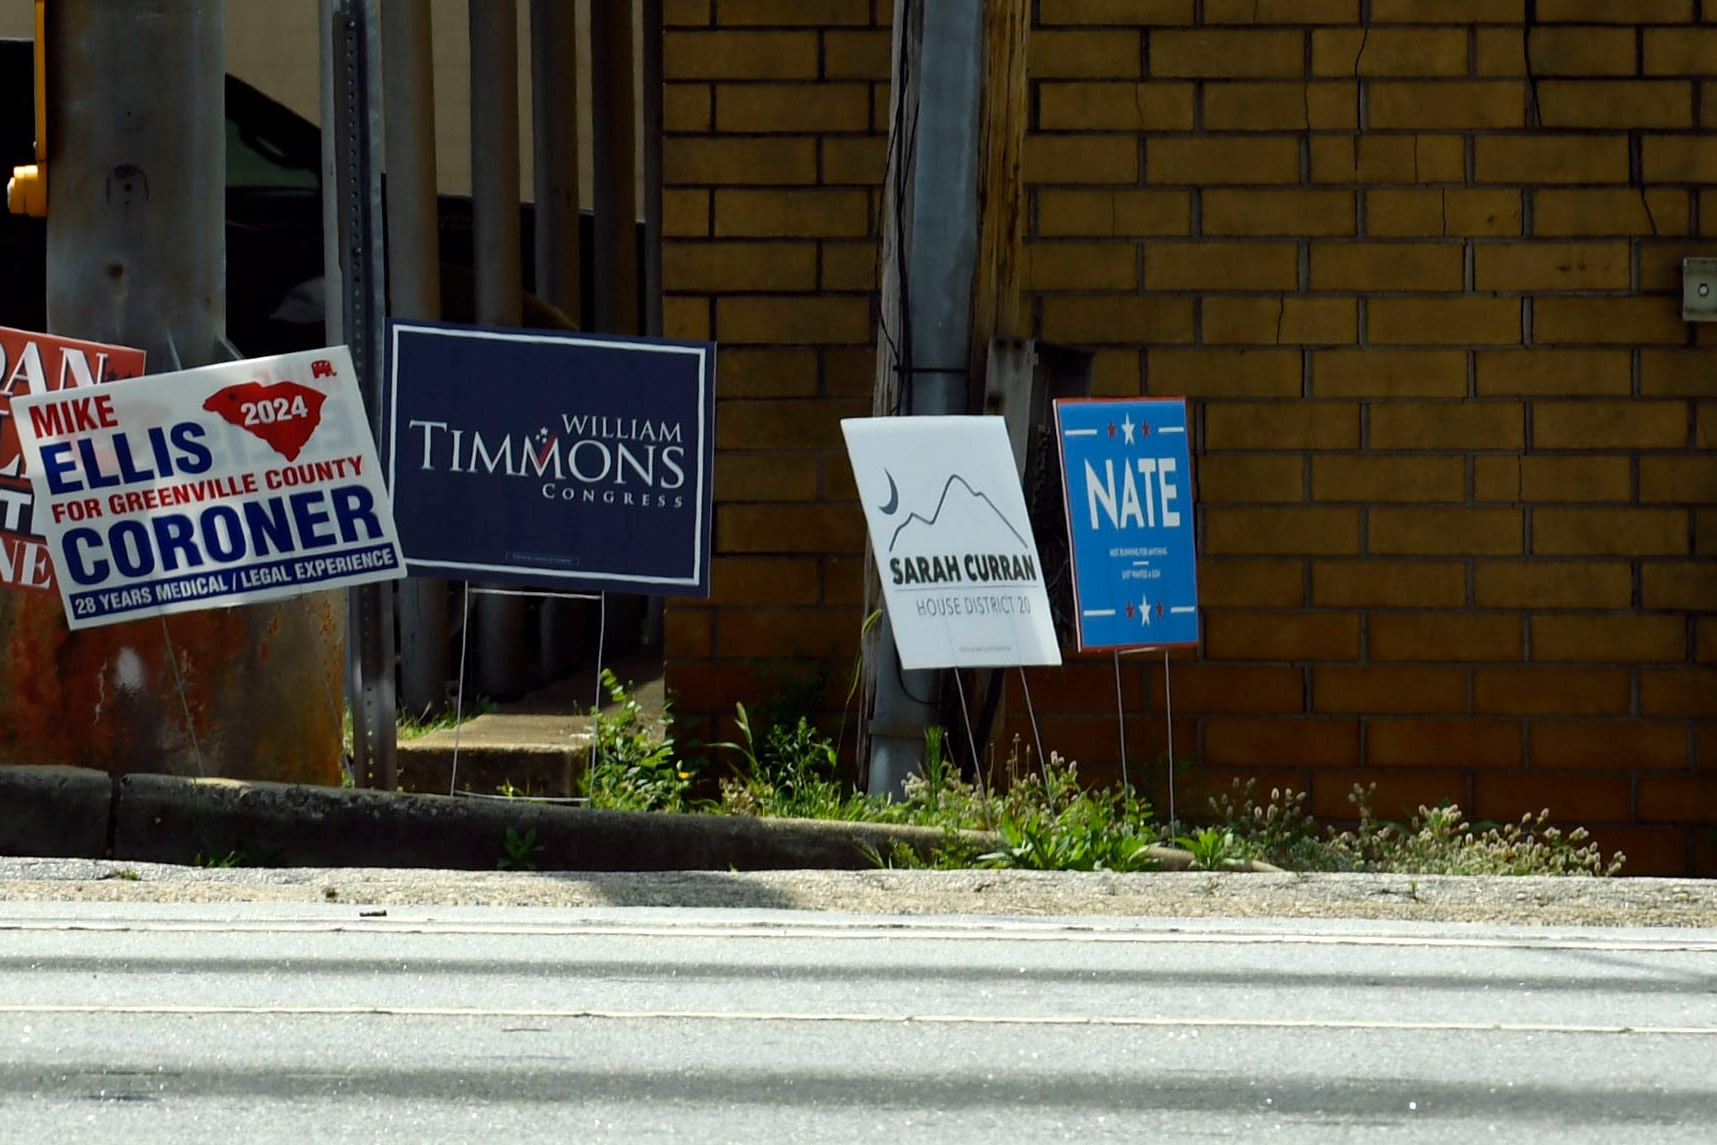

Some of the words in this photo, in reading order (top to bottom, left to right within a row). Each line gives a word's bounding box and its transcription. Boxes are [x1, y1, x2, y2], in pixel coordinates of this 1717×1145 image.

[29, 394, 119, 439] MIKE
[240, 395, 309, 427] 2024
[561, 413, 683, 443] WILLIAM
[39, 421, 213, 496] ELLIS
[409, 419, 685, 489] TIMMONS
[51, 498, 103, 524] FOR
[108, 472, 259, 516] GREENVILLE
[265, 455, 364, 491] COUNTY
[542, 483, 683, 507] CONGRESS
[1084, 456, 1181, 532] NATE
[61, 484, 384, 586] CORONER
[75, 598, 96, 616] 28
[98, 585, 152, 611] YEARS
[155, 574, 229, 602] MEDICAL
[241, 568, 290, 591] LEGAL
[295, 547, 394, 580] EXPERIENCE
[889, 555, 962, 585] SARAH
[963, 553, 1037, 582] CURRAN
[916, 598, 962, 617] HOUSE
[964, 596, 1014, 616] DISTRICT
[1015, 596, 1031, 615] 20
